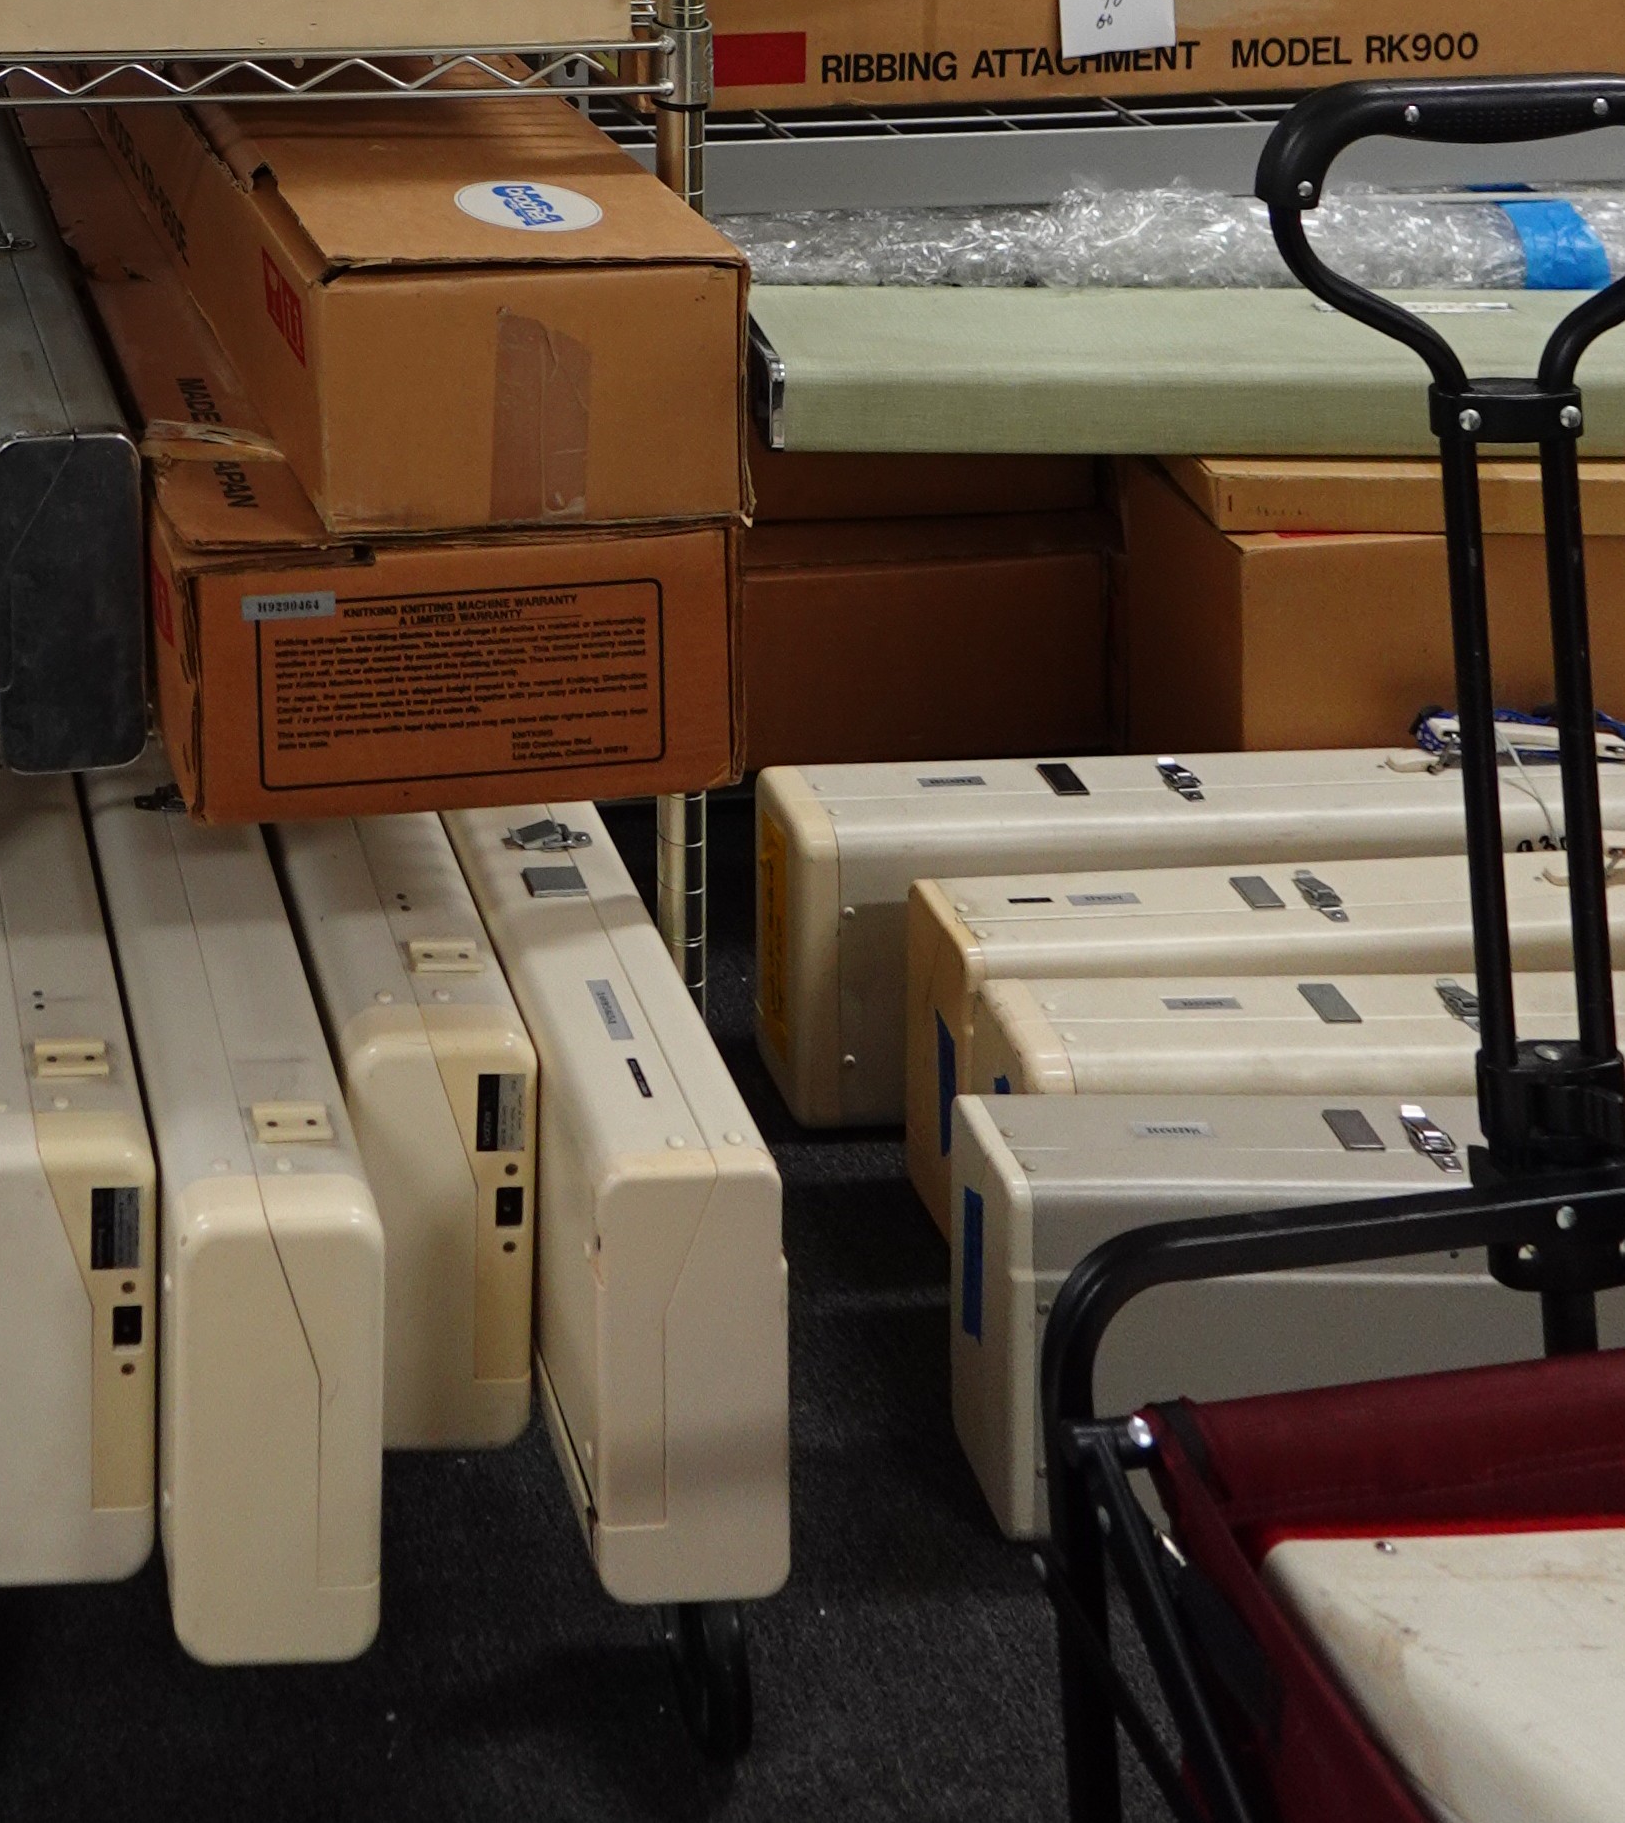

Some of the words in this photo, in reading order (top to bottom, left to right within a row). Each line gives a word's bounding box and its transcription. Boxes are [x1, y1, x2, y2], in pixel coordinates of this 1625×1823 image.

[821, 51, 958, 84] RIBBING
[970, 40, 1201, 78] ATTACHMENT
[1231, 38, 1352, 68] MODEL
[1365, 31, 1479, 64] RK900
[213, 460, 259, 509] APAN
[398, 616, 407, 626] A
[410, 612, 456, 625] LIMITED
[459, 608, 523, 623] WARRANTY
[401, 602, 454, 616] KNITTING
[457, 598, 511, 612] MACHINE
[513, 594, 578, 608] WARRANTY
